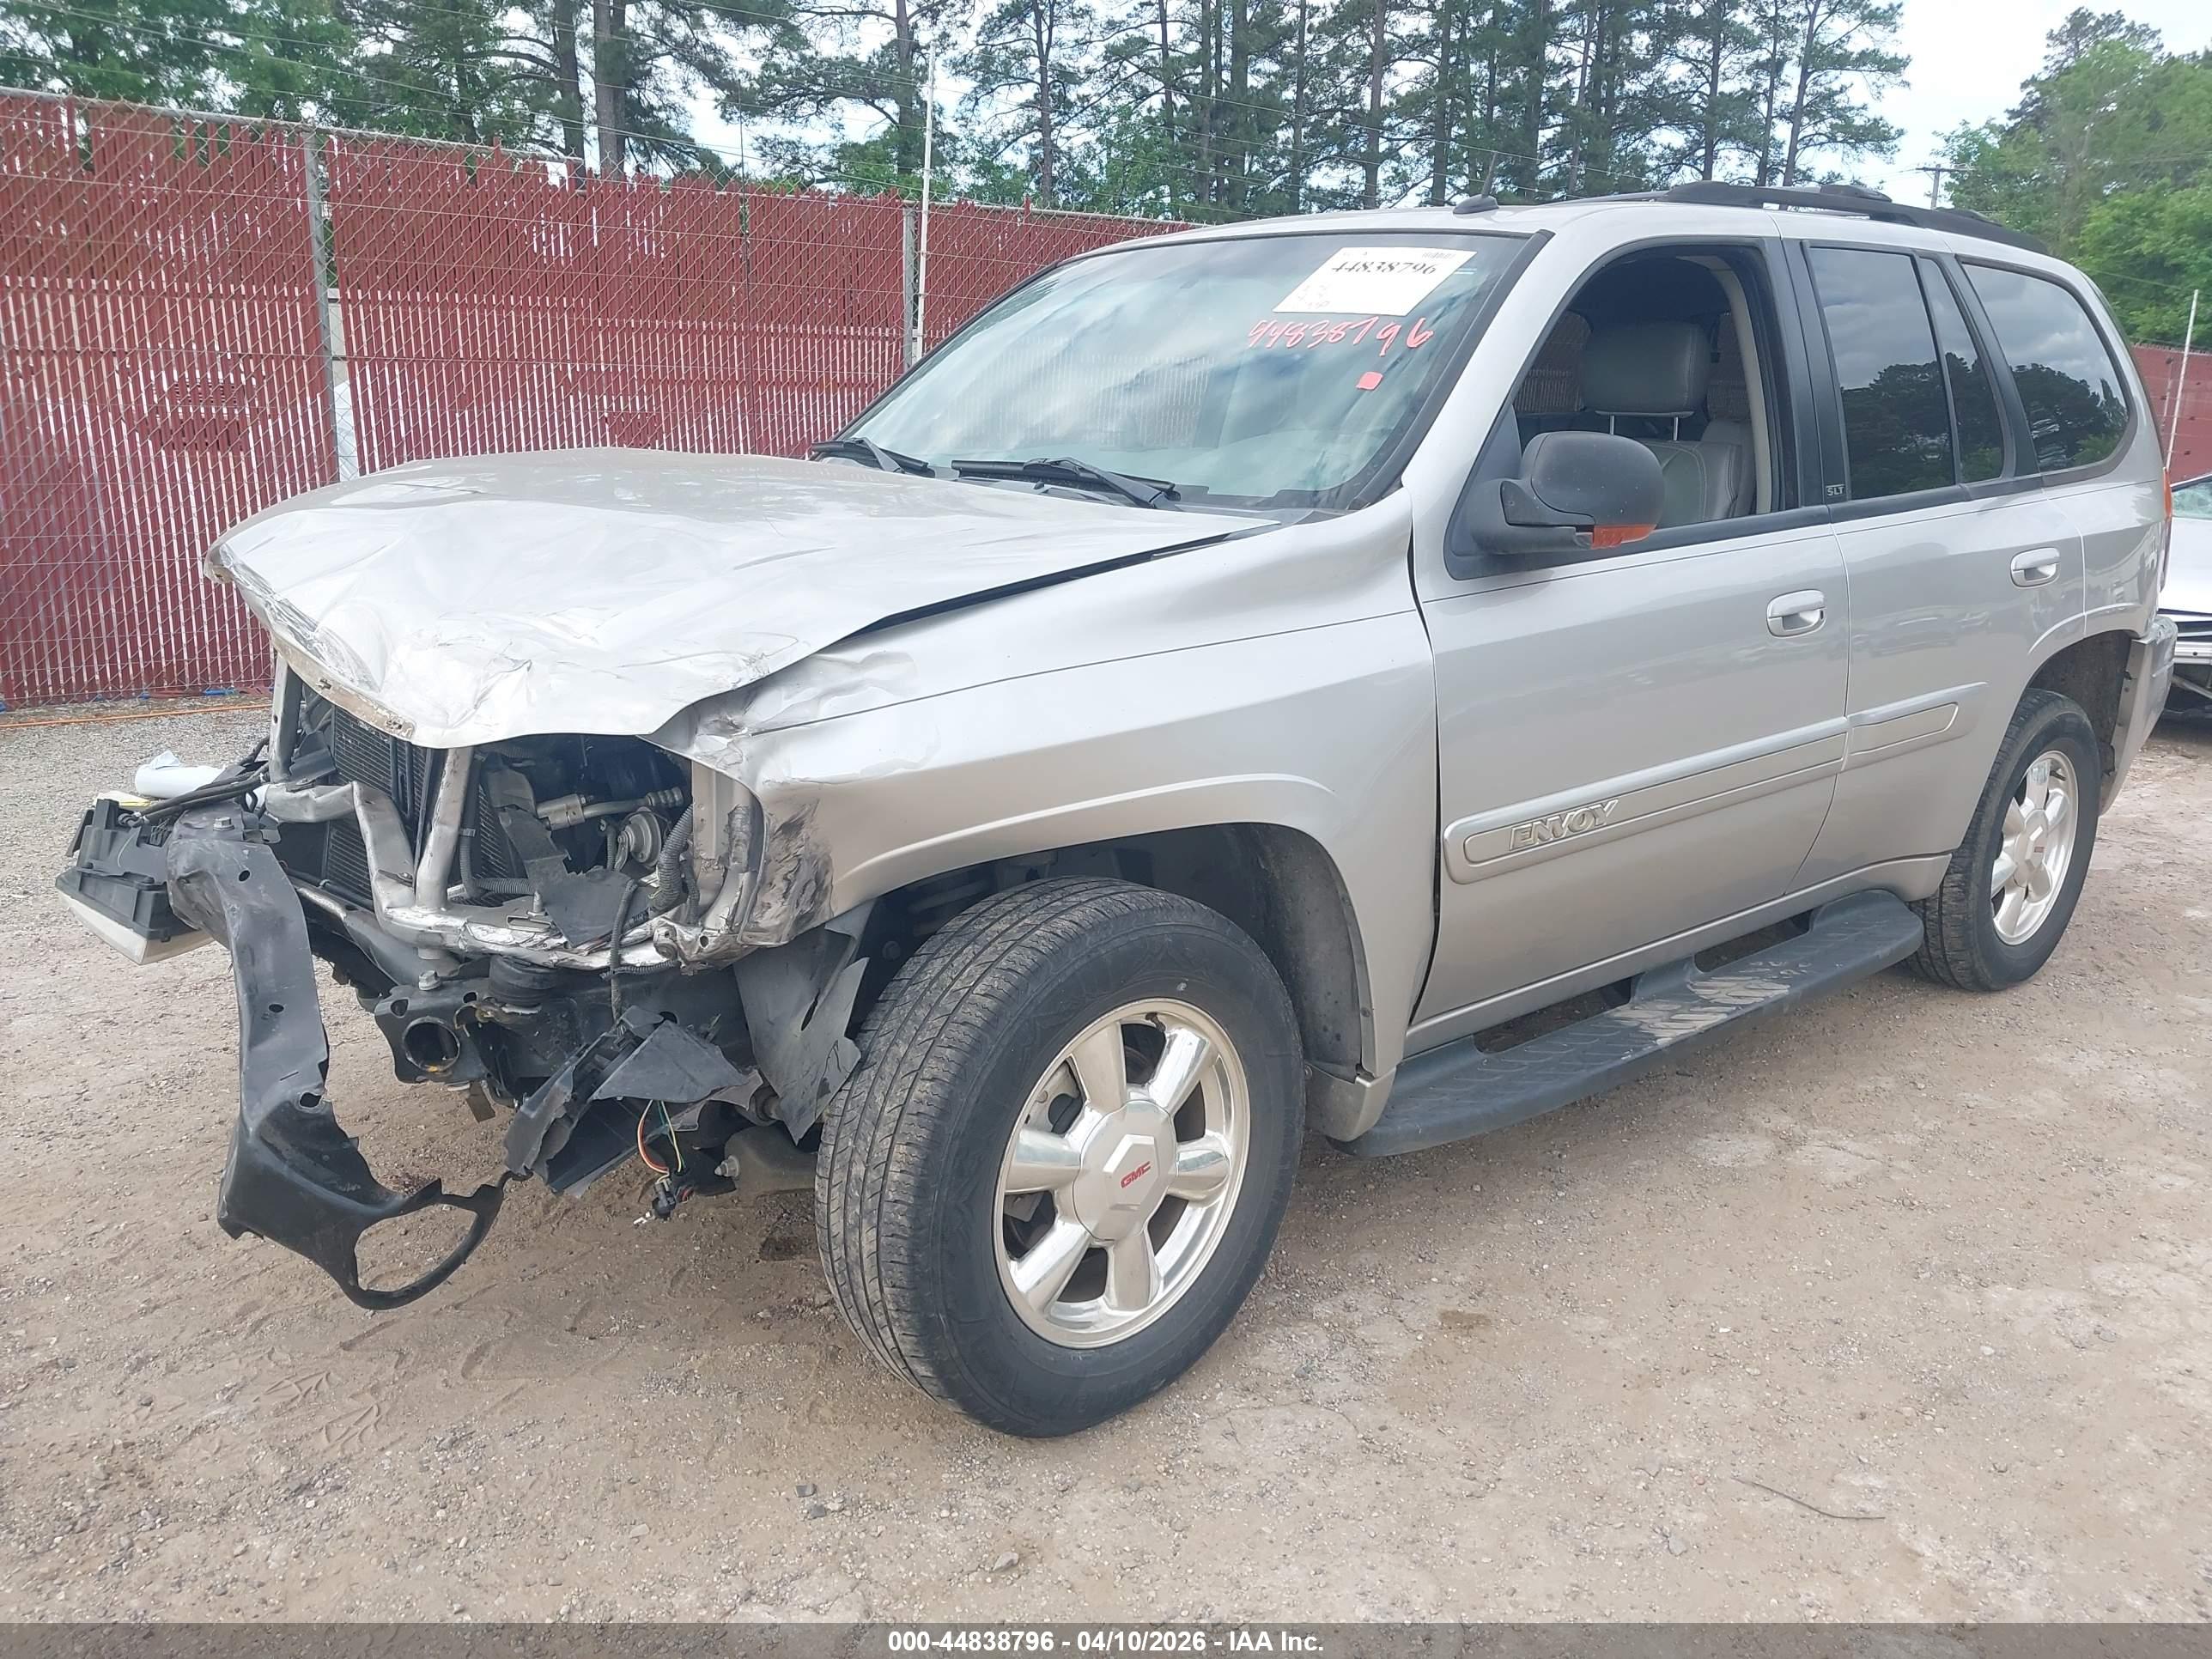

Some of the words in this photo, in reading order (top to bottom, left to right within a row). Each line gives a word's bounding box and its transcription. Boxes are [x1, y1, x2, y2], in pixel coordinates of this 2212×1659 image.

[1332, 261, 1437, 275] 44838796
[1826, 486, 1844, 496] SLT
[1509, 799, 1619, 851] ENVOY
[1120, 1161, 1152, 1188] GMC
